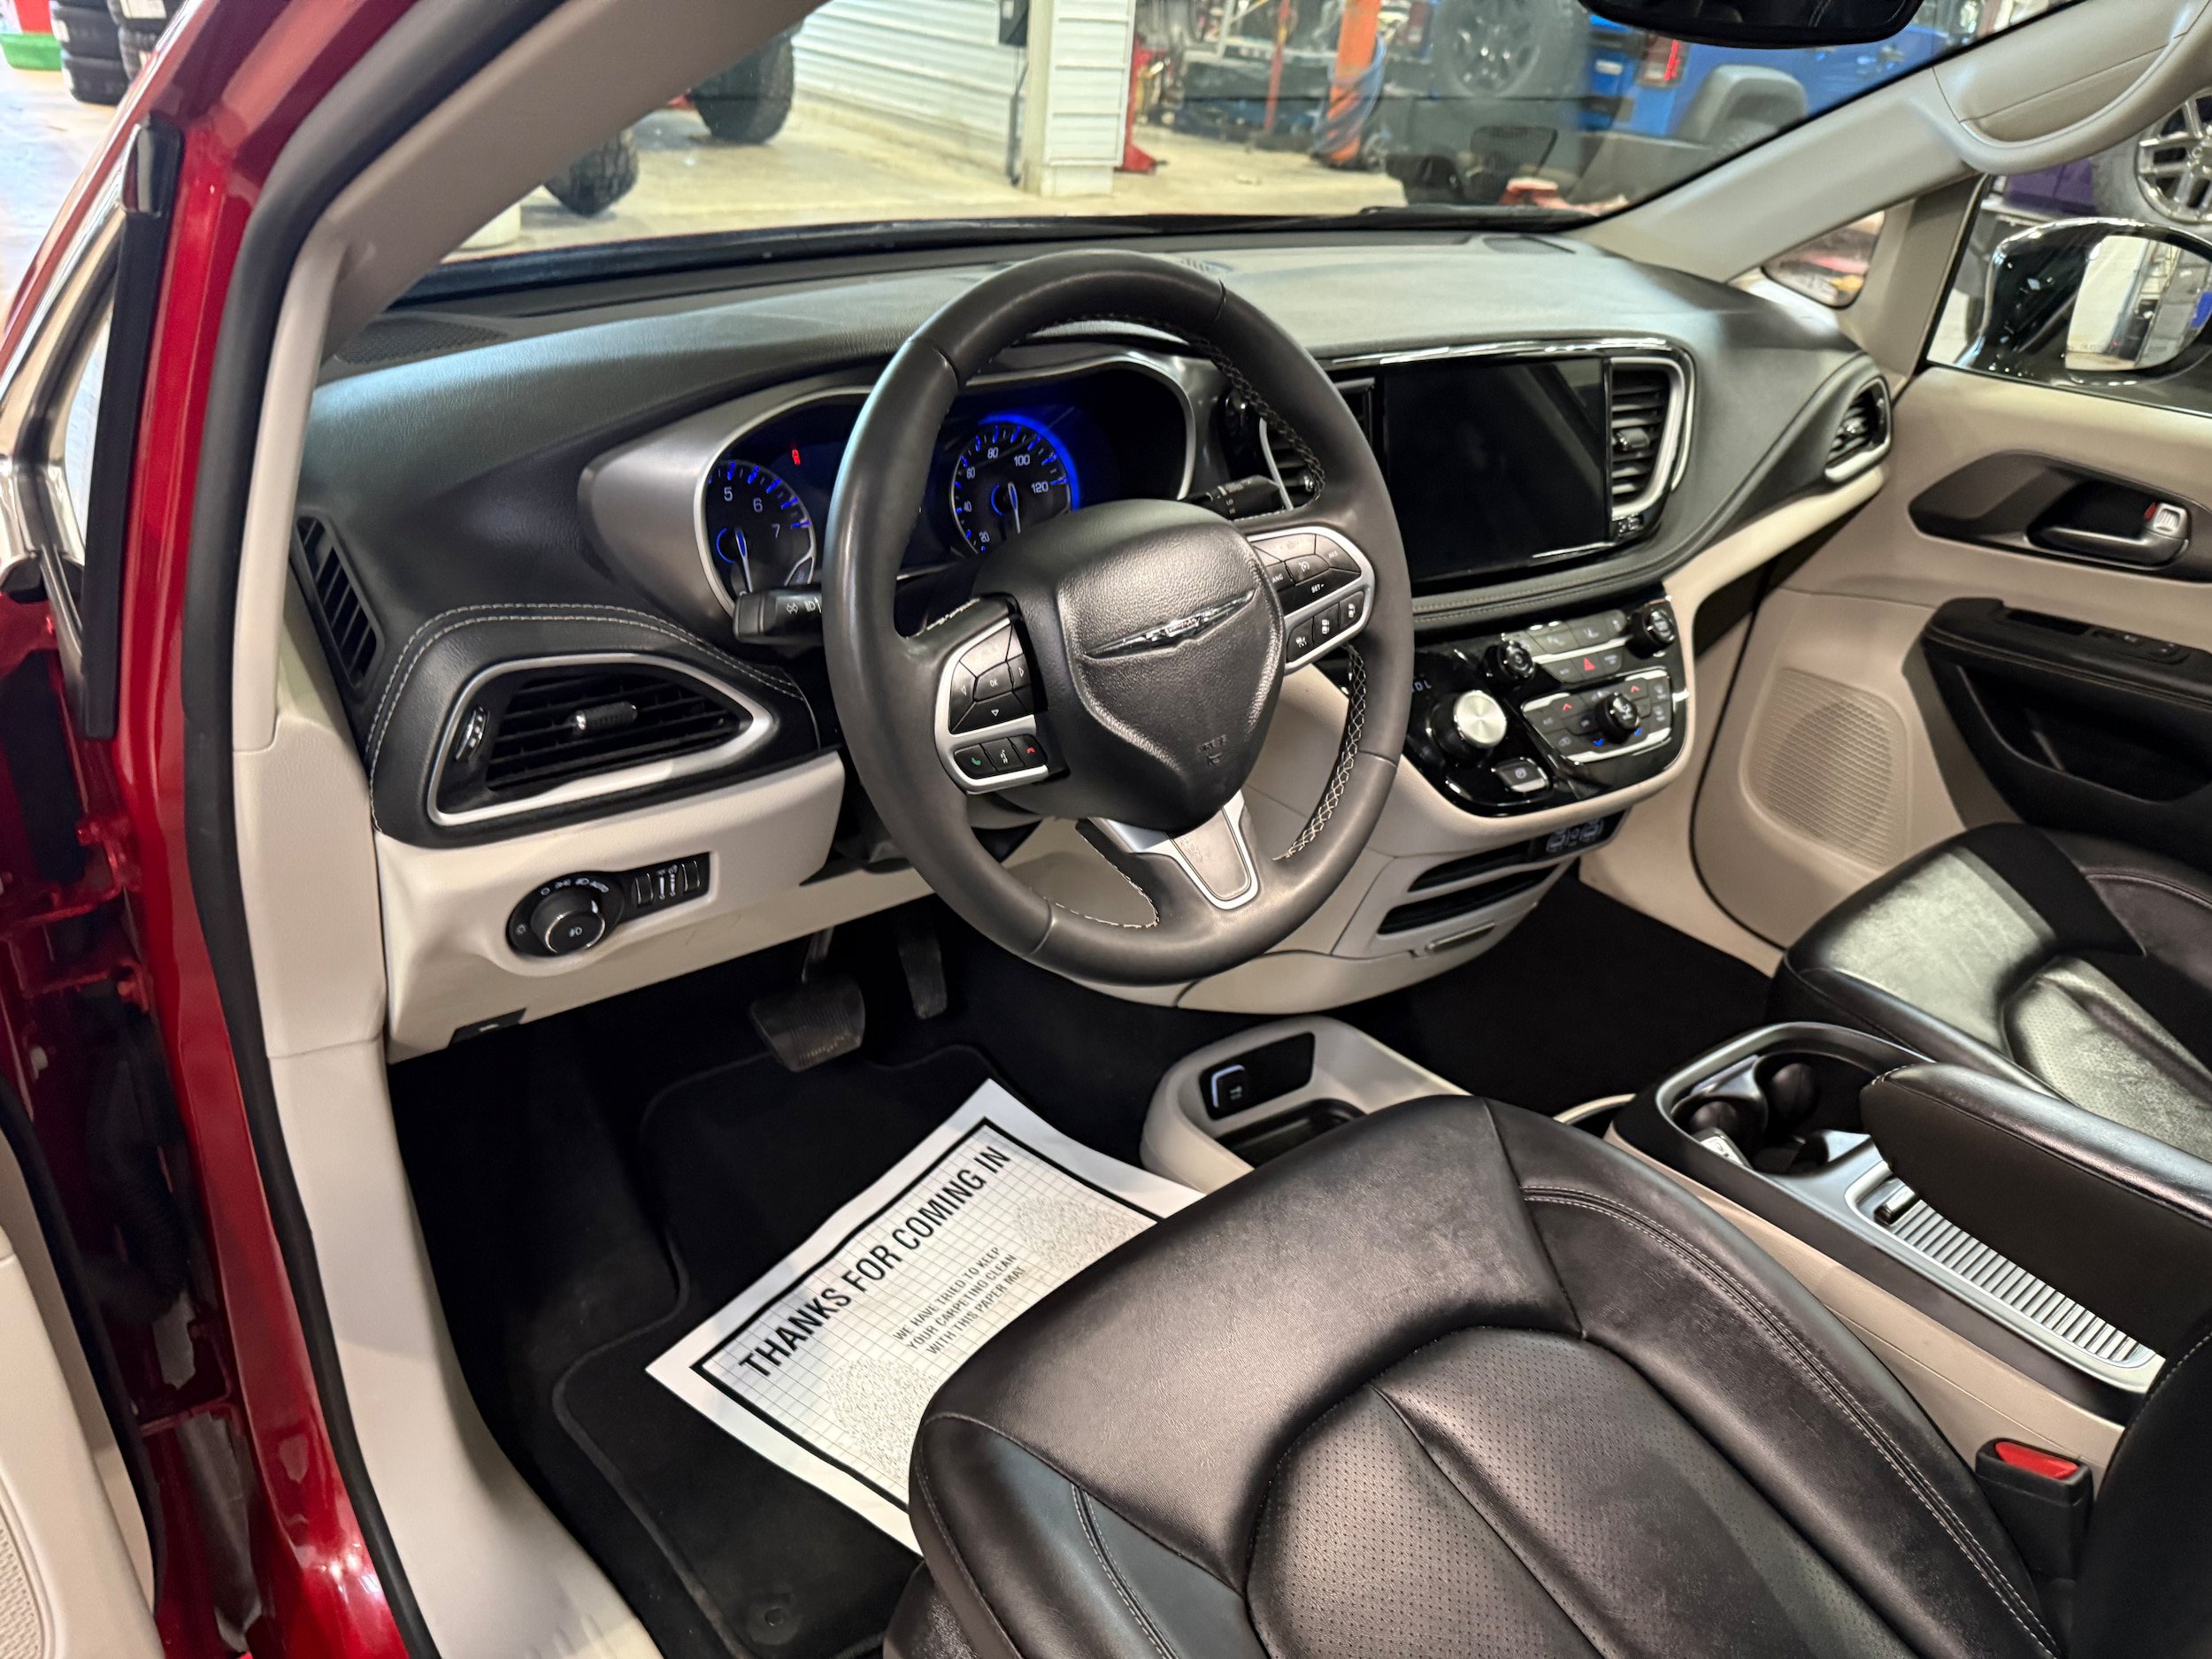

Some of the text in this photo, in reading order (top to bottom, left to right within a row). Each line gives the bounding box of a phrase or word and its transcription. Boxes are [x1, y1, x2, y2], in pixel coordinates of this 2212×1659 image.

[987, 447, 999, 459] 80
[1013, 454, 1031, 467] 100
[724, 486, 733, 502] 5
[1031, 480, 1049, 494] 120
[753, 497, 764, 513] 6
[771, 523, 780, 538] 7
[979, 531, 990, 543] 20
[1271, 573, 1284, 583] ANC
[989, 678, 999, 687] OK
[738, 1145, 1011, 1377] THANKS FOR COMING IN
[892, 1246, 1001, 1341] WE HAVE TRIED TO KEEP
[906, 1254, 1018, 1350] YOUR CARPETING CLEAN
[926, 1264, 1026, 1356] WITH THIS PAPER MAT
